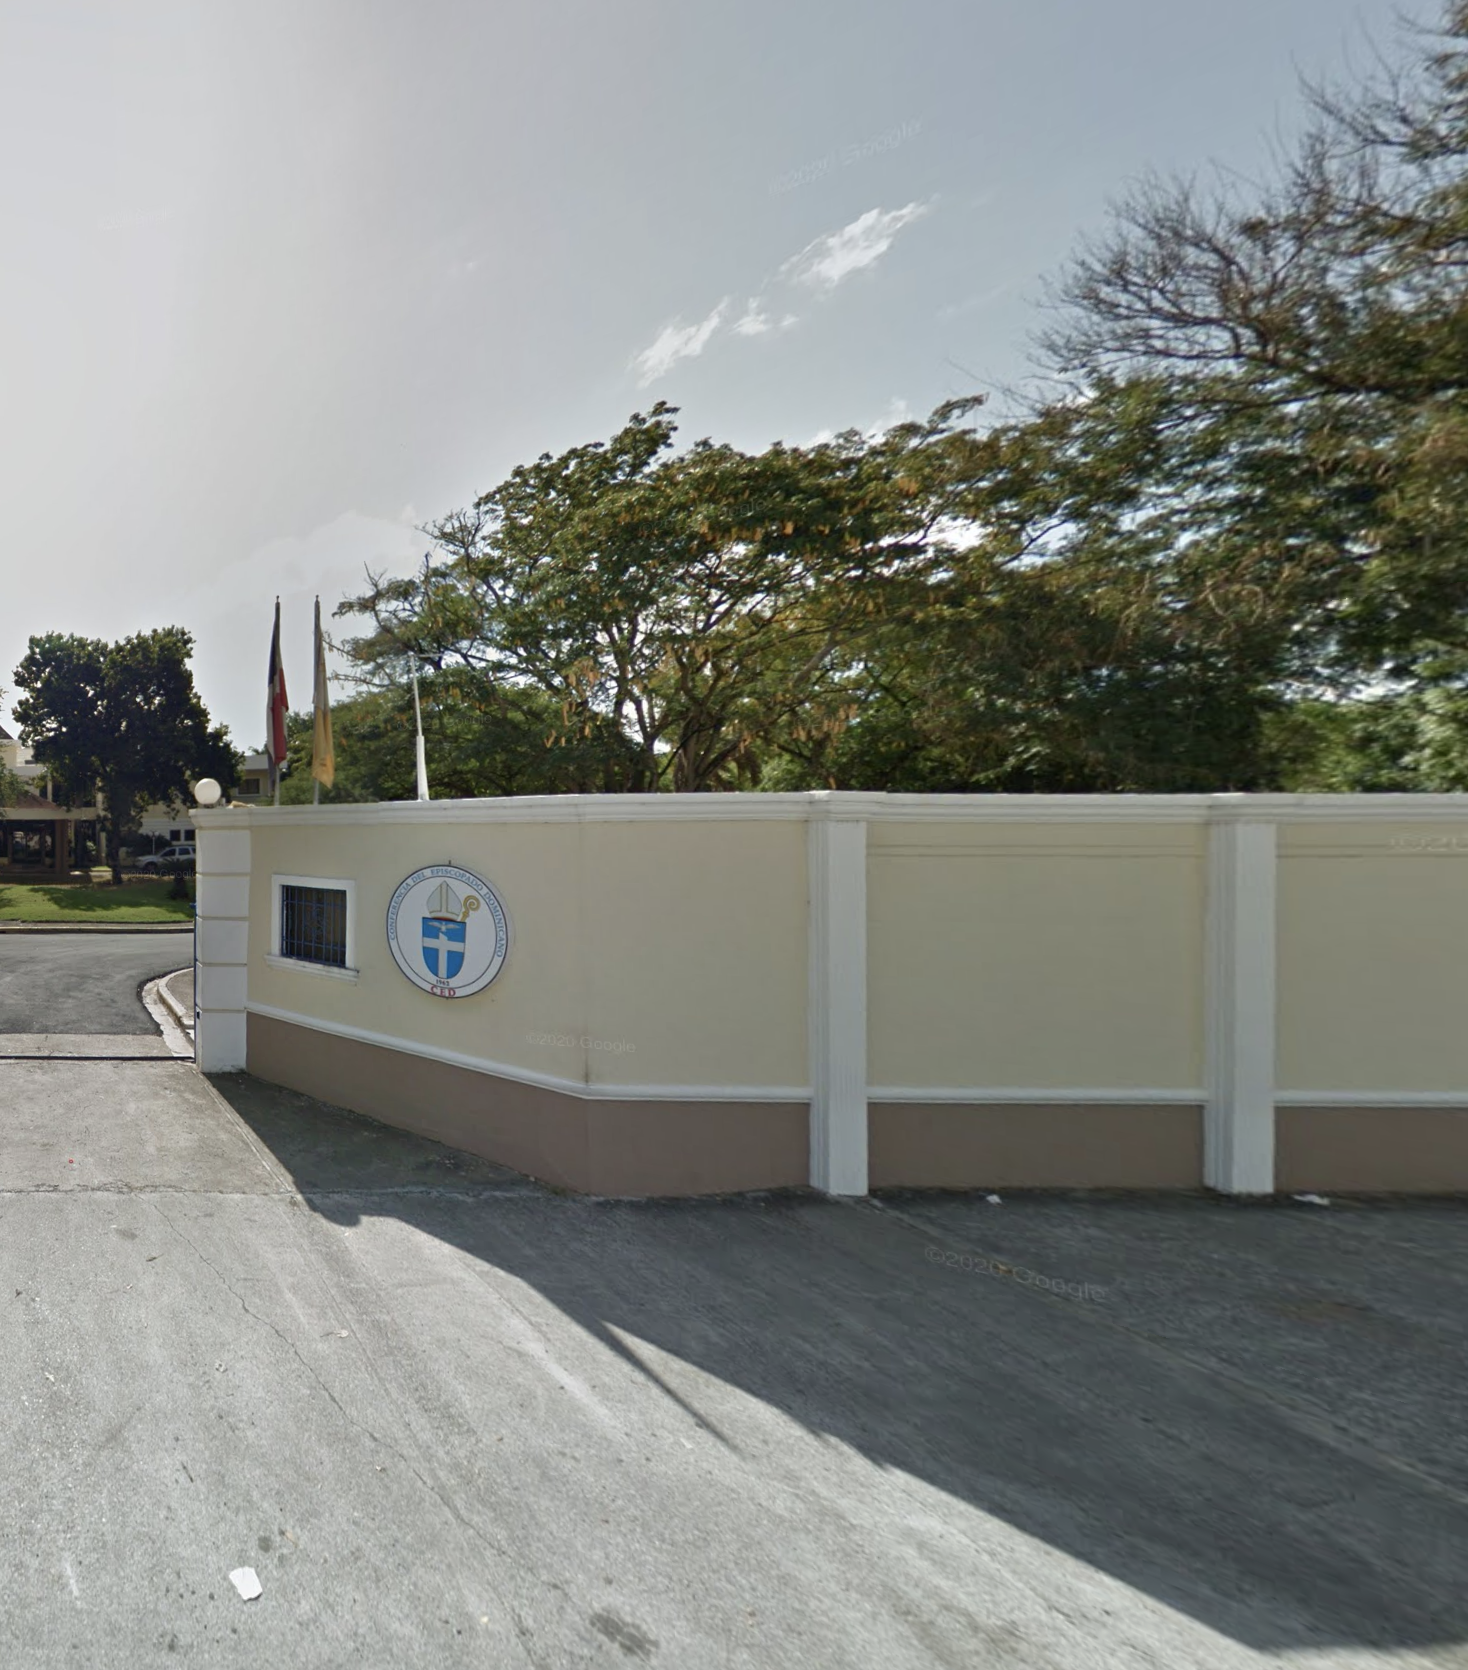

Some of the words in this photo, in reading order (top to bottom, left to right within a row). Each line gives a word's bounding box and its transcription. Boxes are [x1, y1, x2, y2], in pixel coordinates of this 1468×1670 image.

[389, 882, 411, 941] CONFERENCIA
[411, 872, 427, 884] DEL
[431, 868, 483, 892] EPISCOPADO
[484, 891, 506, 958] DOMINICANO
[431, 985, 456, 997] CED
